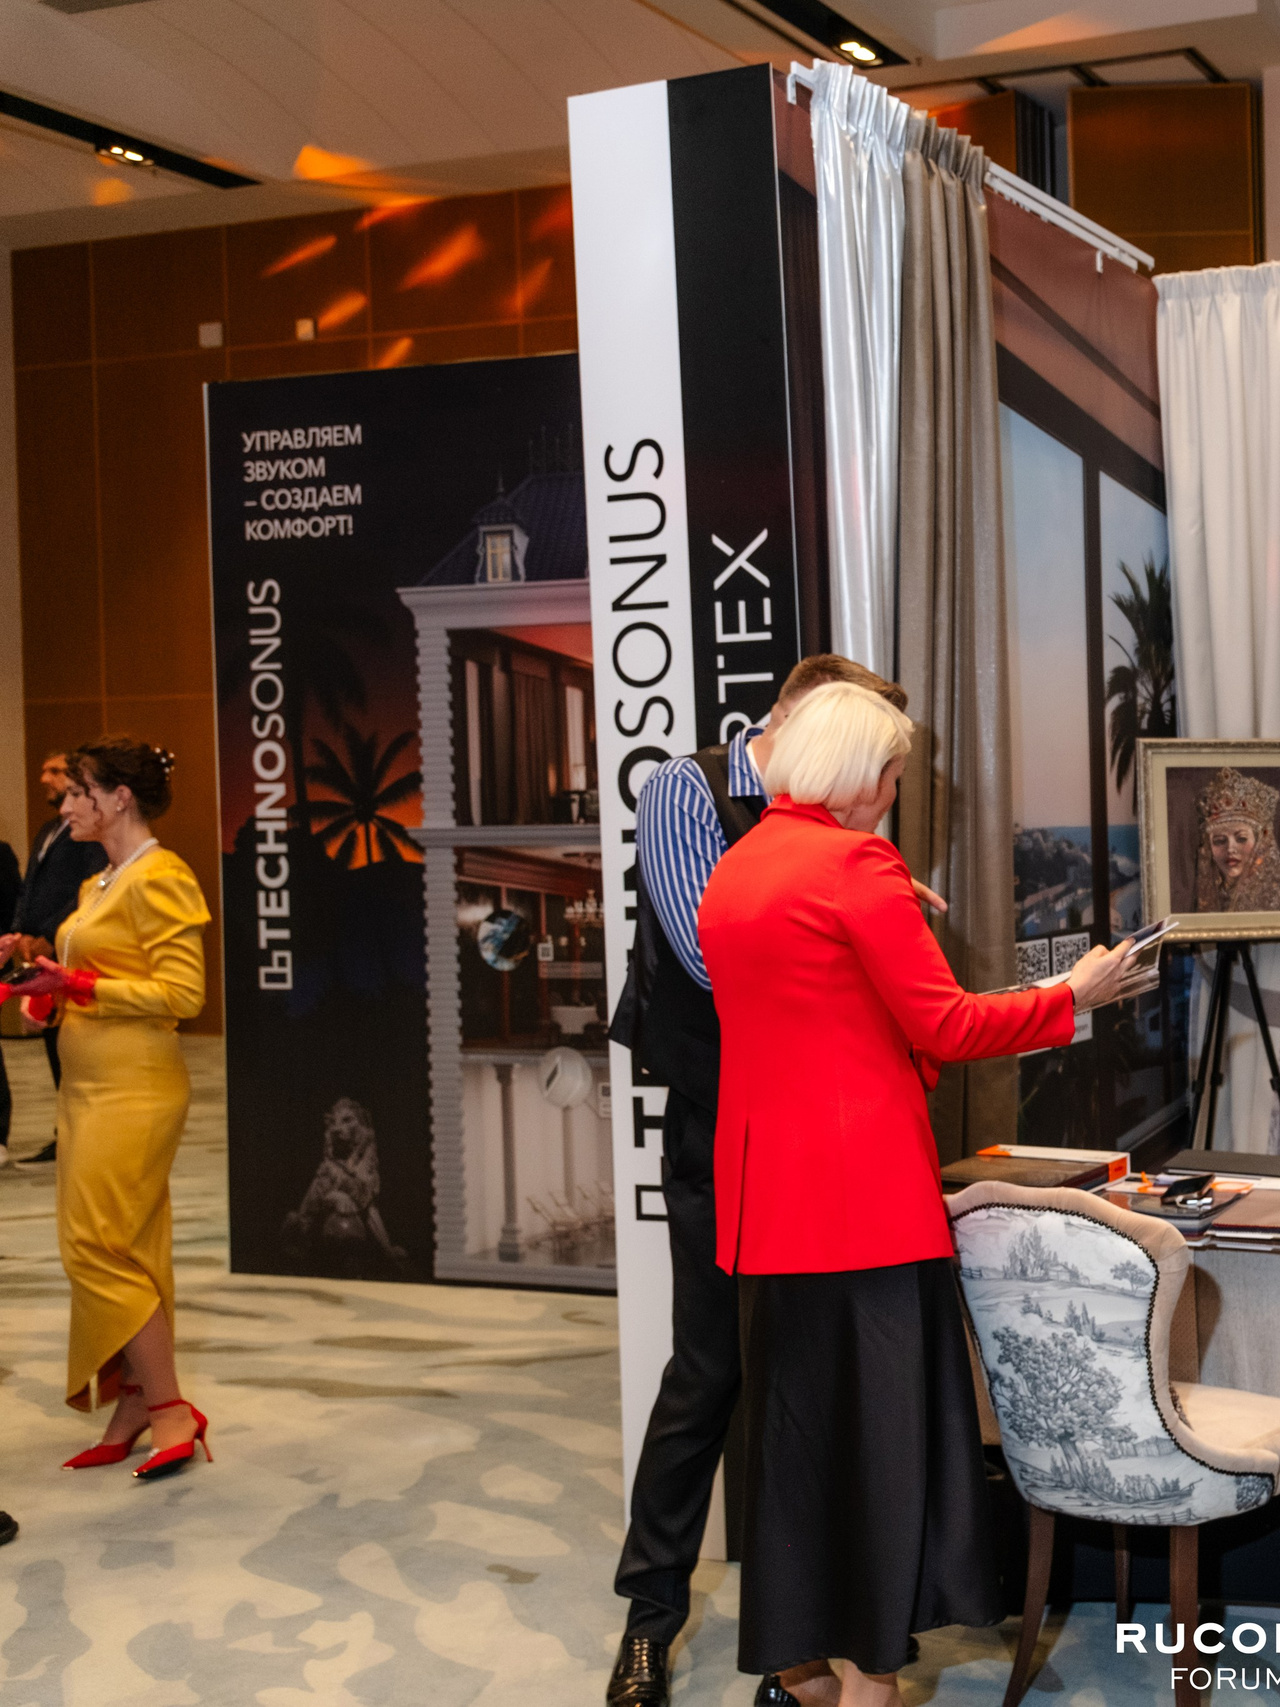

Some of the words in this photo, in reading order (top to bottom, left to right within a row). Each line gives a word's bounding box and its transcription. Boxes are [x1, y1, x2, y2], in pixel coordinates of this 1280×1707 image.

[241, 424, 362, 453] УПРАВЛЯЕМ
[243, 456, 326, 483] ЗВУКОМ
[260, 484, 362, 513] СОЗДАЕМ
[245, 514, 354, 541] КОМФОРТ!
[247, 578, 293, 950] TECHNOSONUS
